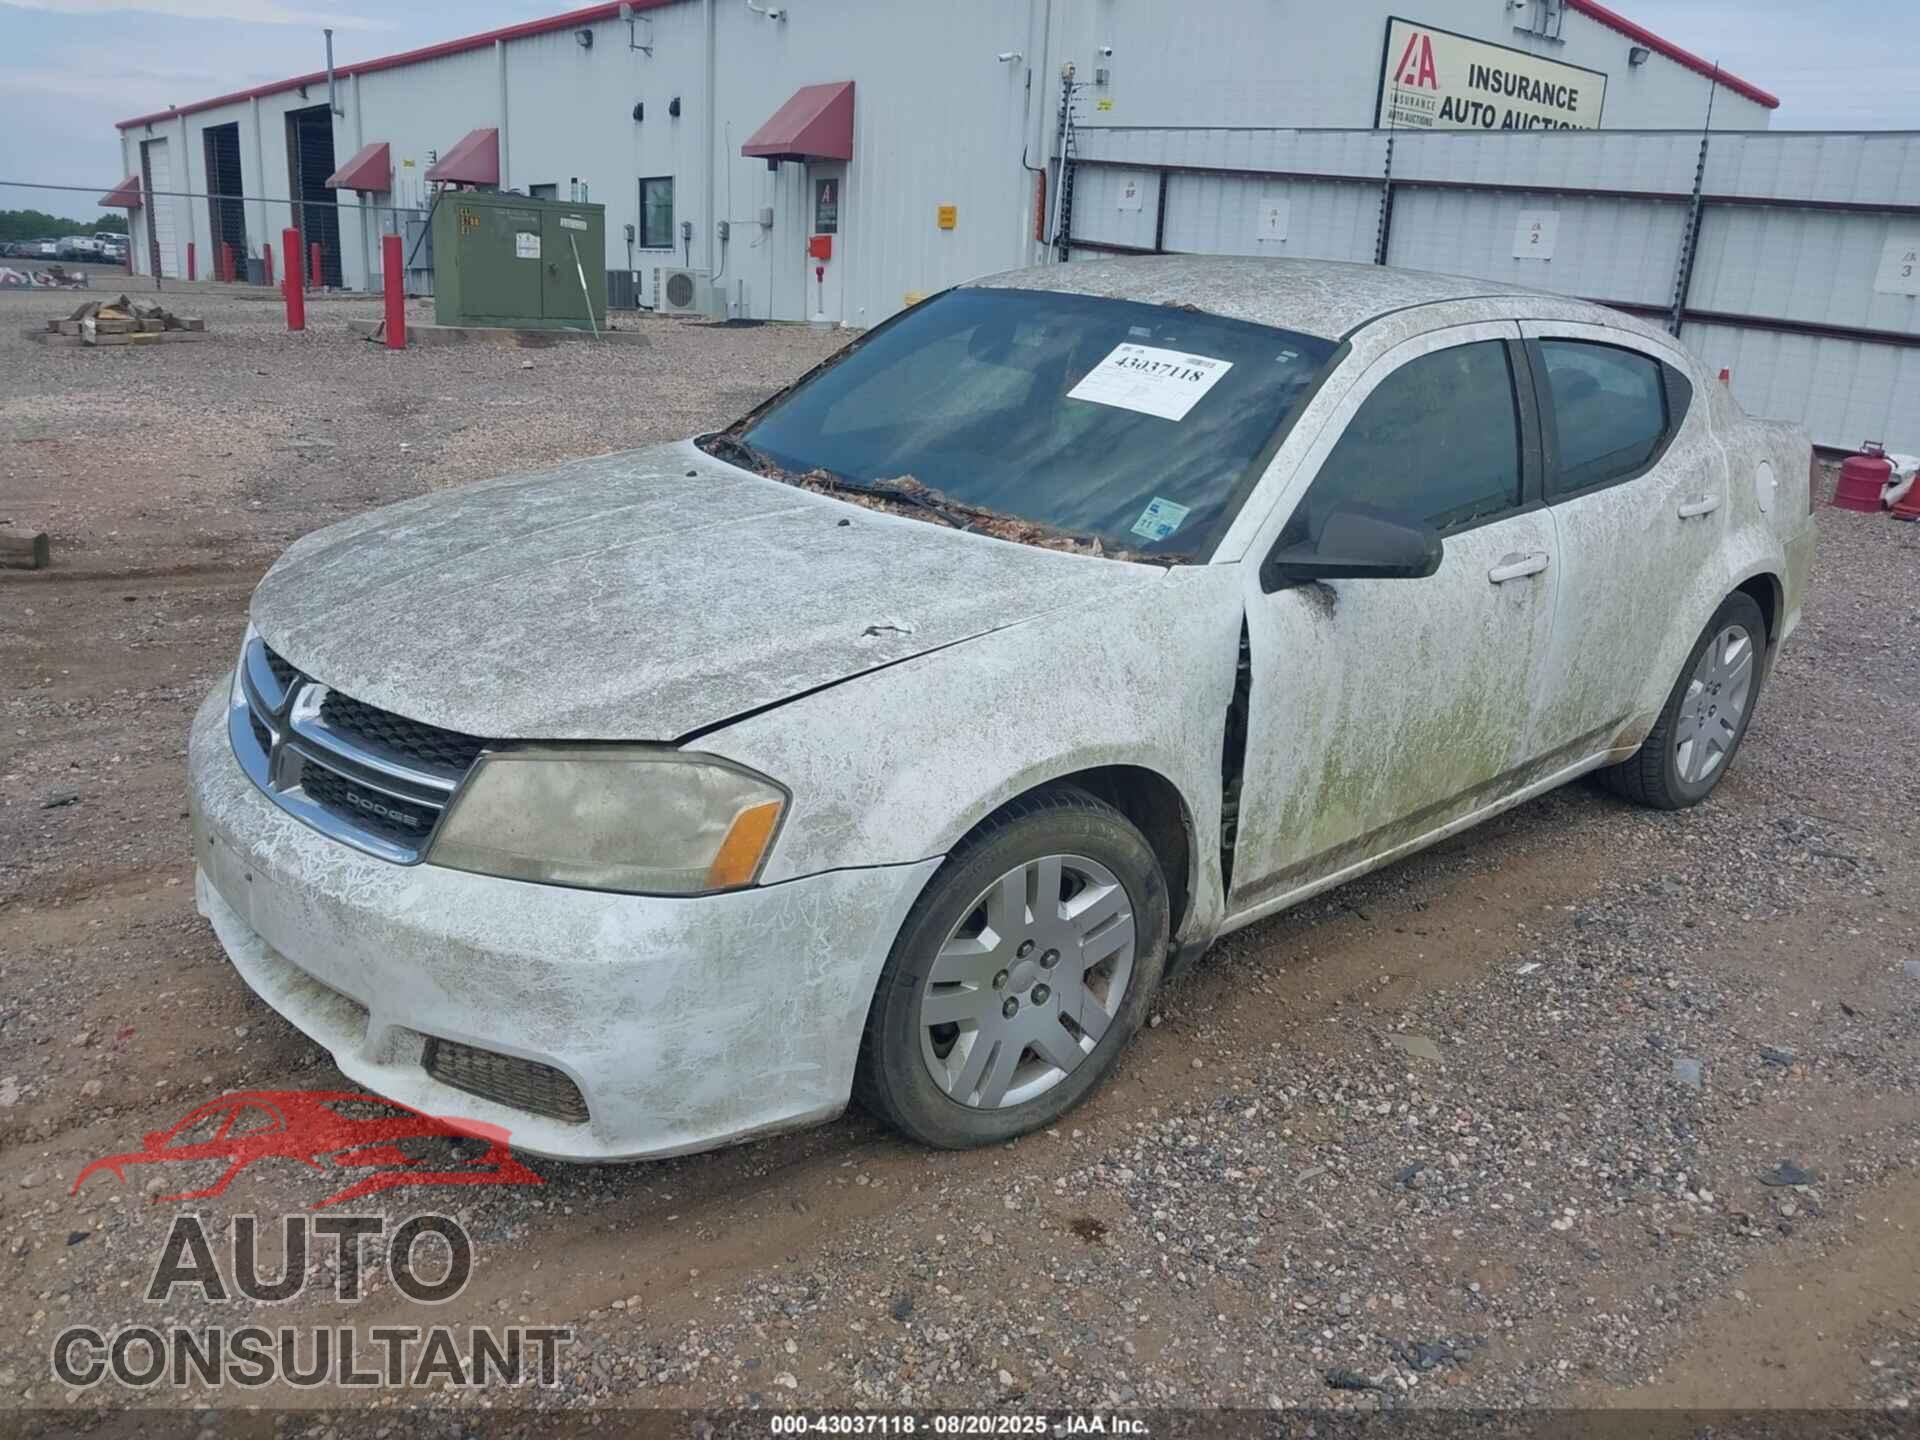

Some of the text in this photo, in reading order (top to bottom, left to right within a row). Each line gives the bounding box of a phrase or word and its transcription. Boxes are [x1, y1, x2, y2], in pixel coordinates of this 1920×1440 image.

[1468, 63, 1578, 111] INSURANCE
[1439, 95, 1496, 128] AUTO
[1531, 233, 1540, 244] 2
[1901, 264, 1912, 278] 3
[1114, 356, 1205, 382] 43037118
[346, 792, 418, 826] DODGE
